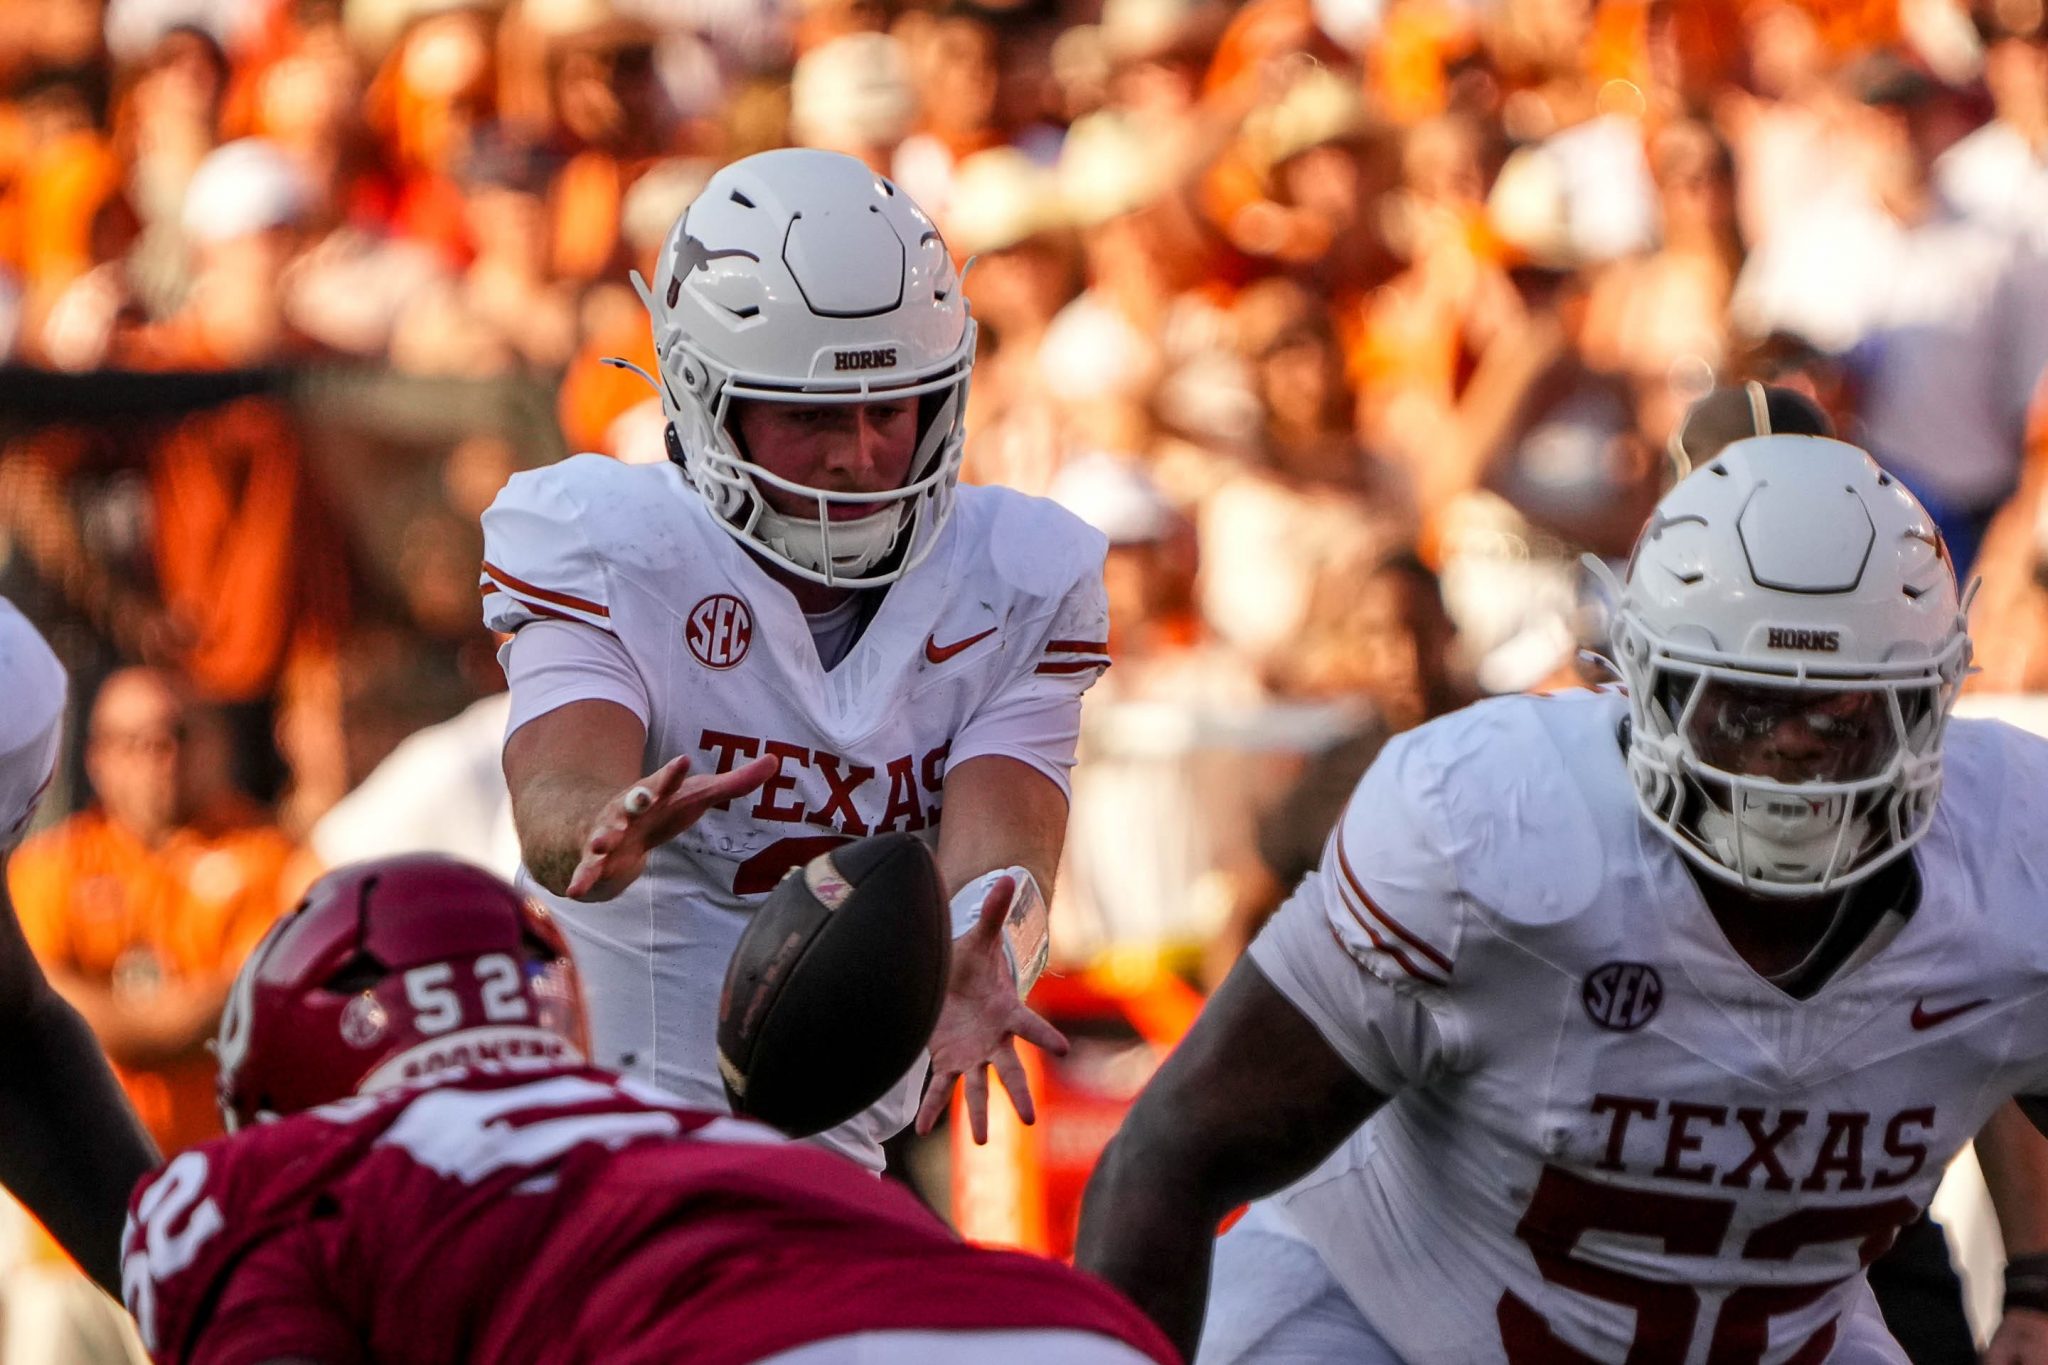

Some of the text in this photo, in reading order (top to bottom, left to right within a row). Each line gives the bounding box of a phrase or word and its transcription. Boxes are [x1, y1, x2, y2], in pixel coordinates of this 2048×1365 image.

[834, 348, 897, 371] HORNS
[691, 598, 752, 665] SEC
[1767, 627, 1840, 652] HORNS
[405, 953, 529, 1036] 52
[1585, 963, 1659, 1031] SEC
[1591, 1093, 1936, 1192] TEXAS
[1496, 1163, 1920, 1365] 52
